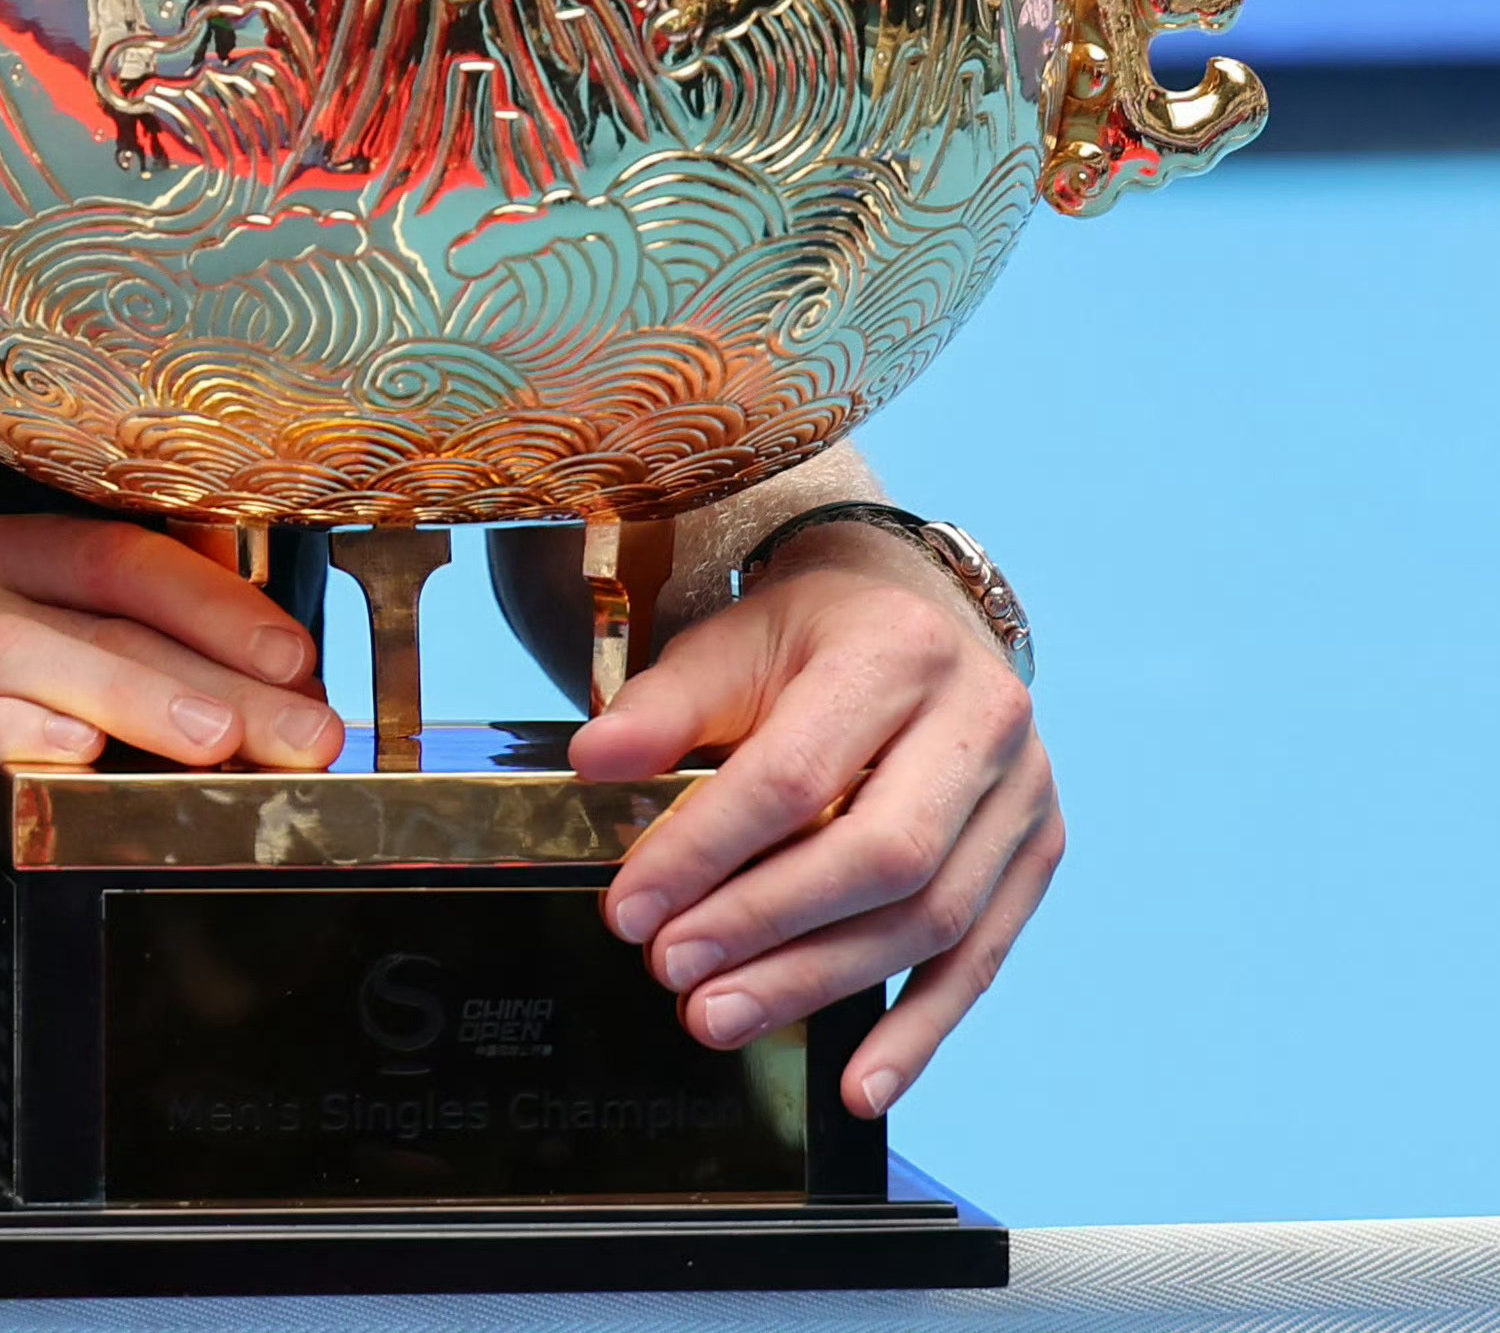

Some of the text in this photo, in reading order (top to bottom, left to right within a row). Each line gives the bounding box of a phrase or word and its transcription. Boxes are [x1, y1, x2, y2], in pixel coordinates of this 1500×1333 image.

[462, 997, 554, 1021] CHINA
[457, 1021, 544, 1043] OPEN
[320, 1089, 490, 1140] Singles
